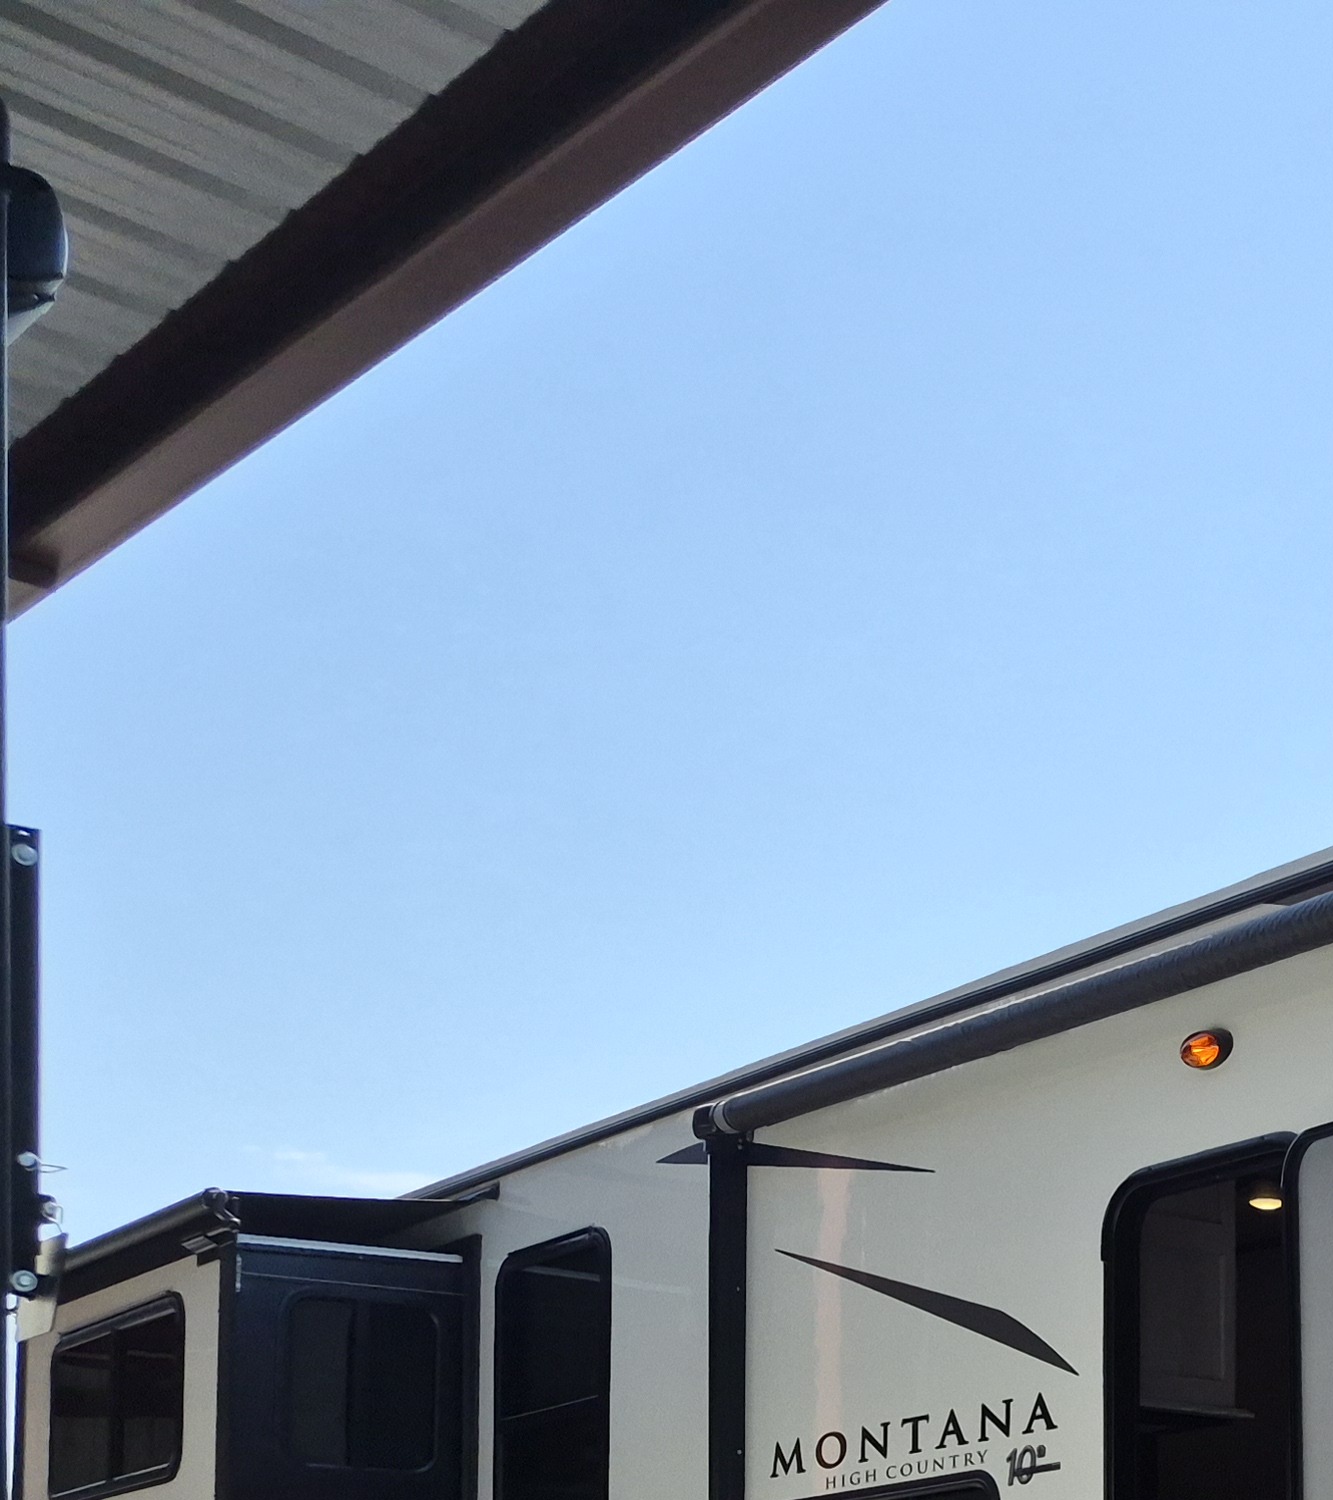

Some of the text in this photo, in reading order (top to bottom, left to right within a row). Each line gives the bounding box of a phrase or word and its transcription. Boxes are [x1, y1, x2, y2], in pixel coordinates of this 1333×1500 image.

[769, 1391, 1058, 1478] MONTANA
[825, 1468, 878, 1490] HIGH
[885, 1448, 989, 1480] COUNTRY
